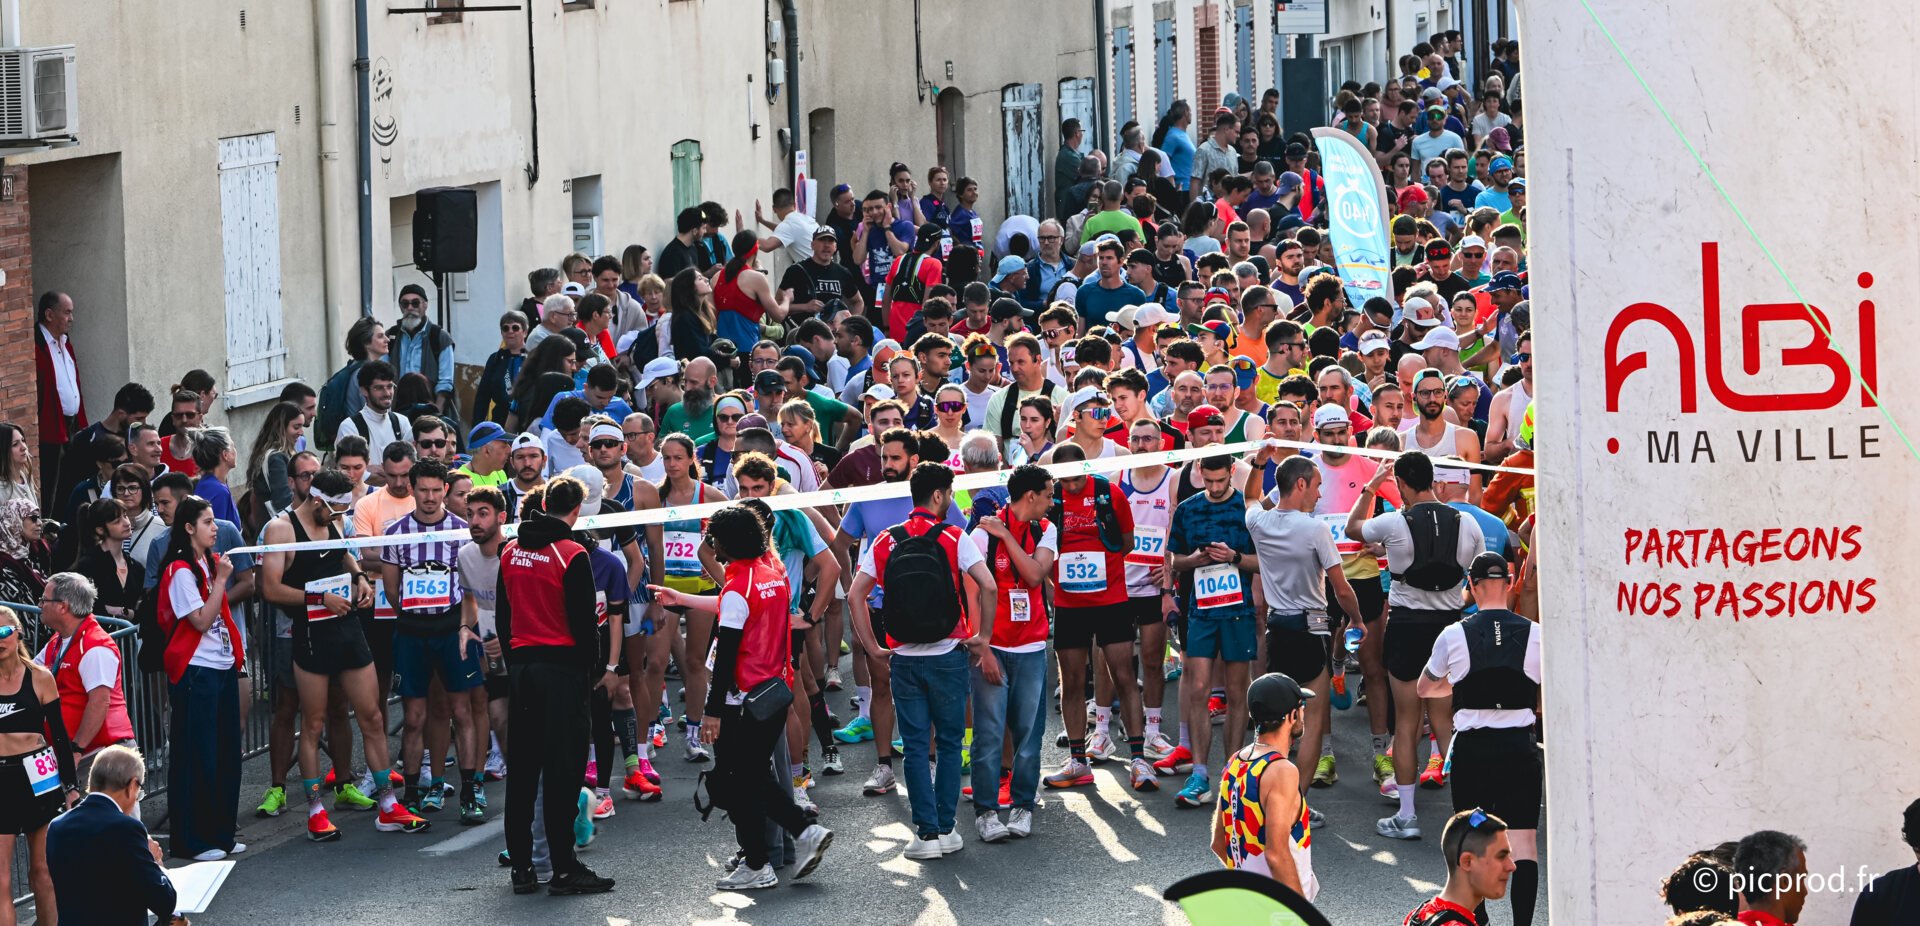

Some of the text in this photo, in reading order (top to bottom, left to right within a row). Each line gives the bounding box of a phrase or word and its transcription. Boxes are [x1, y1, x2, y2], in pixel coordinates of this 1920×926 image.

[2, 178, 13, 196] 231
[1647, 425, 1881, 464] MA VILLE
[665, 542, 694, 557] 732
[1134, 536, 1163, 553] 057
[1624, 525, 1863, 569] PARTAGEONS
[511, 548, 550, 563] Marathon
[1066, 563, 1098, 579] 532
[407, 580, 448, 595] 1563
[1198, 573, 1239, 594] 1040
[1617, 577, 1877, 622] NOS PASSIONS
